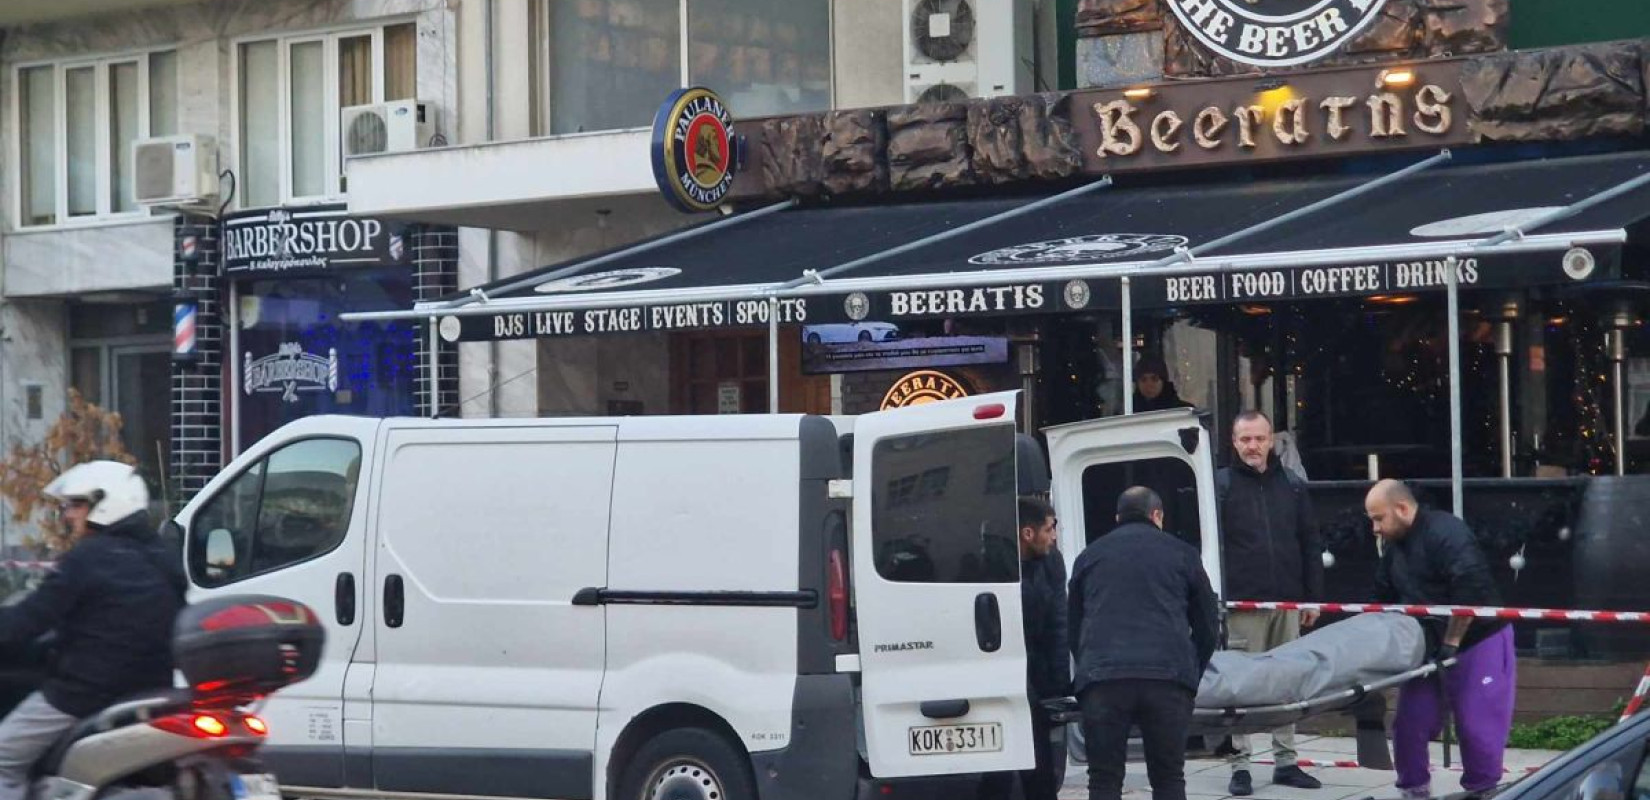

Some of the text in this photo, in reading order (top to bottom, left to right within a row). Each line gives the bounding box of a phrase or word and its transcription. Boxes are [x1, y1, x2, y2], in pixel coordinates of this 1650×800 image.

[1180, 0, 1349, 57] HE BEER
[675, 97, 735, 141] PAULANER
[226, 219, 381, 261] BARBERSHOP
[890, 284, 1045, 316] BEERATIS
[1166, 275, 1217, 302] BEER
[1232, 271, 1285, 298] FOOD
[1301, 265, 1380, 294] COFFEE
[494, 314, 524, 338] DJS
[536, 311, 574, 335] LIVE
[584, 308, 642, 333] STAGE
[652, 302, 723, 329] EVENTS
[874, 641, 934, 653] PRIMASTAR
[912, 727, 996, 752] KOK 3311
